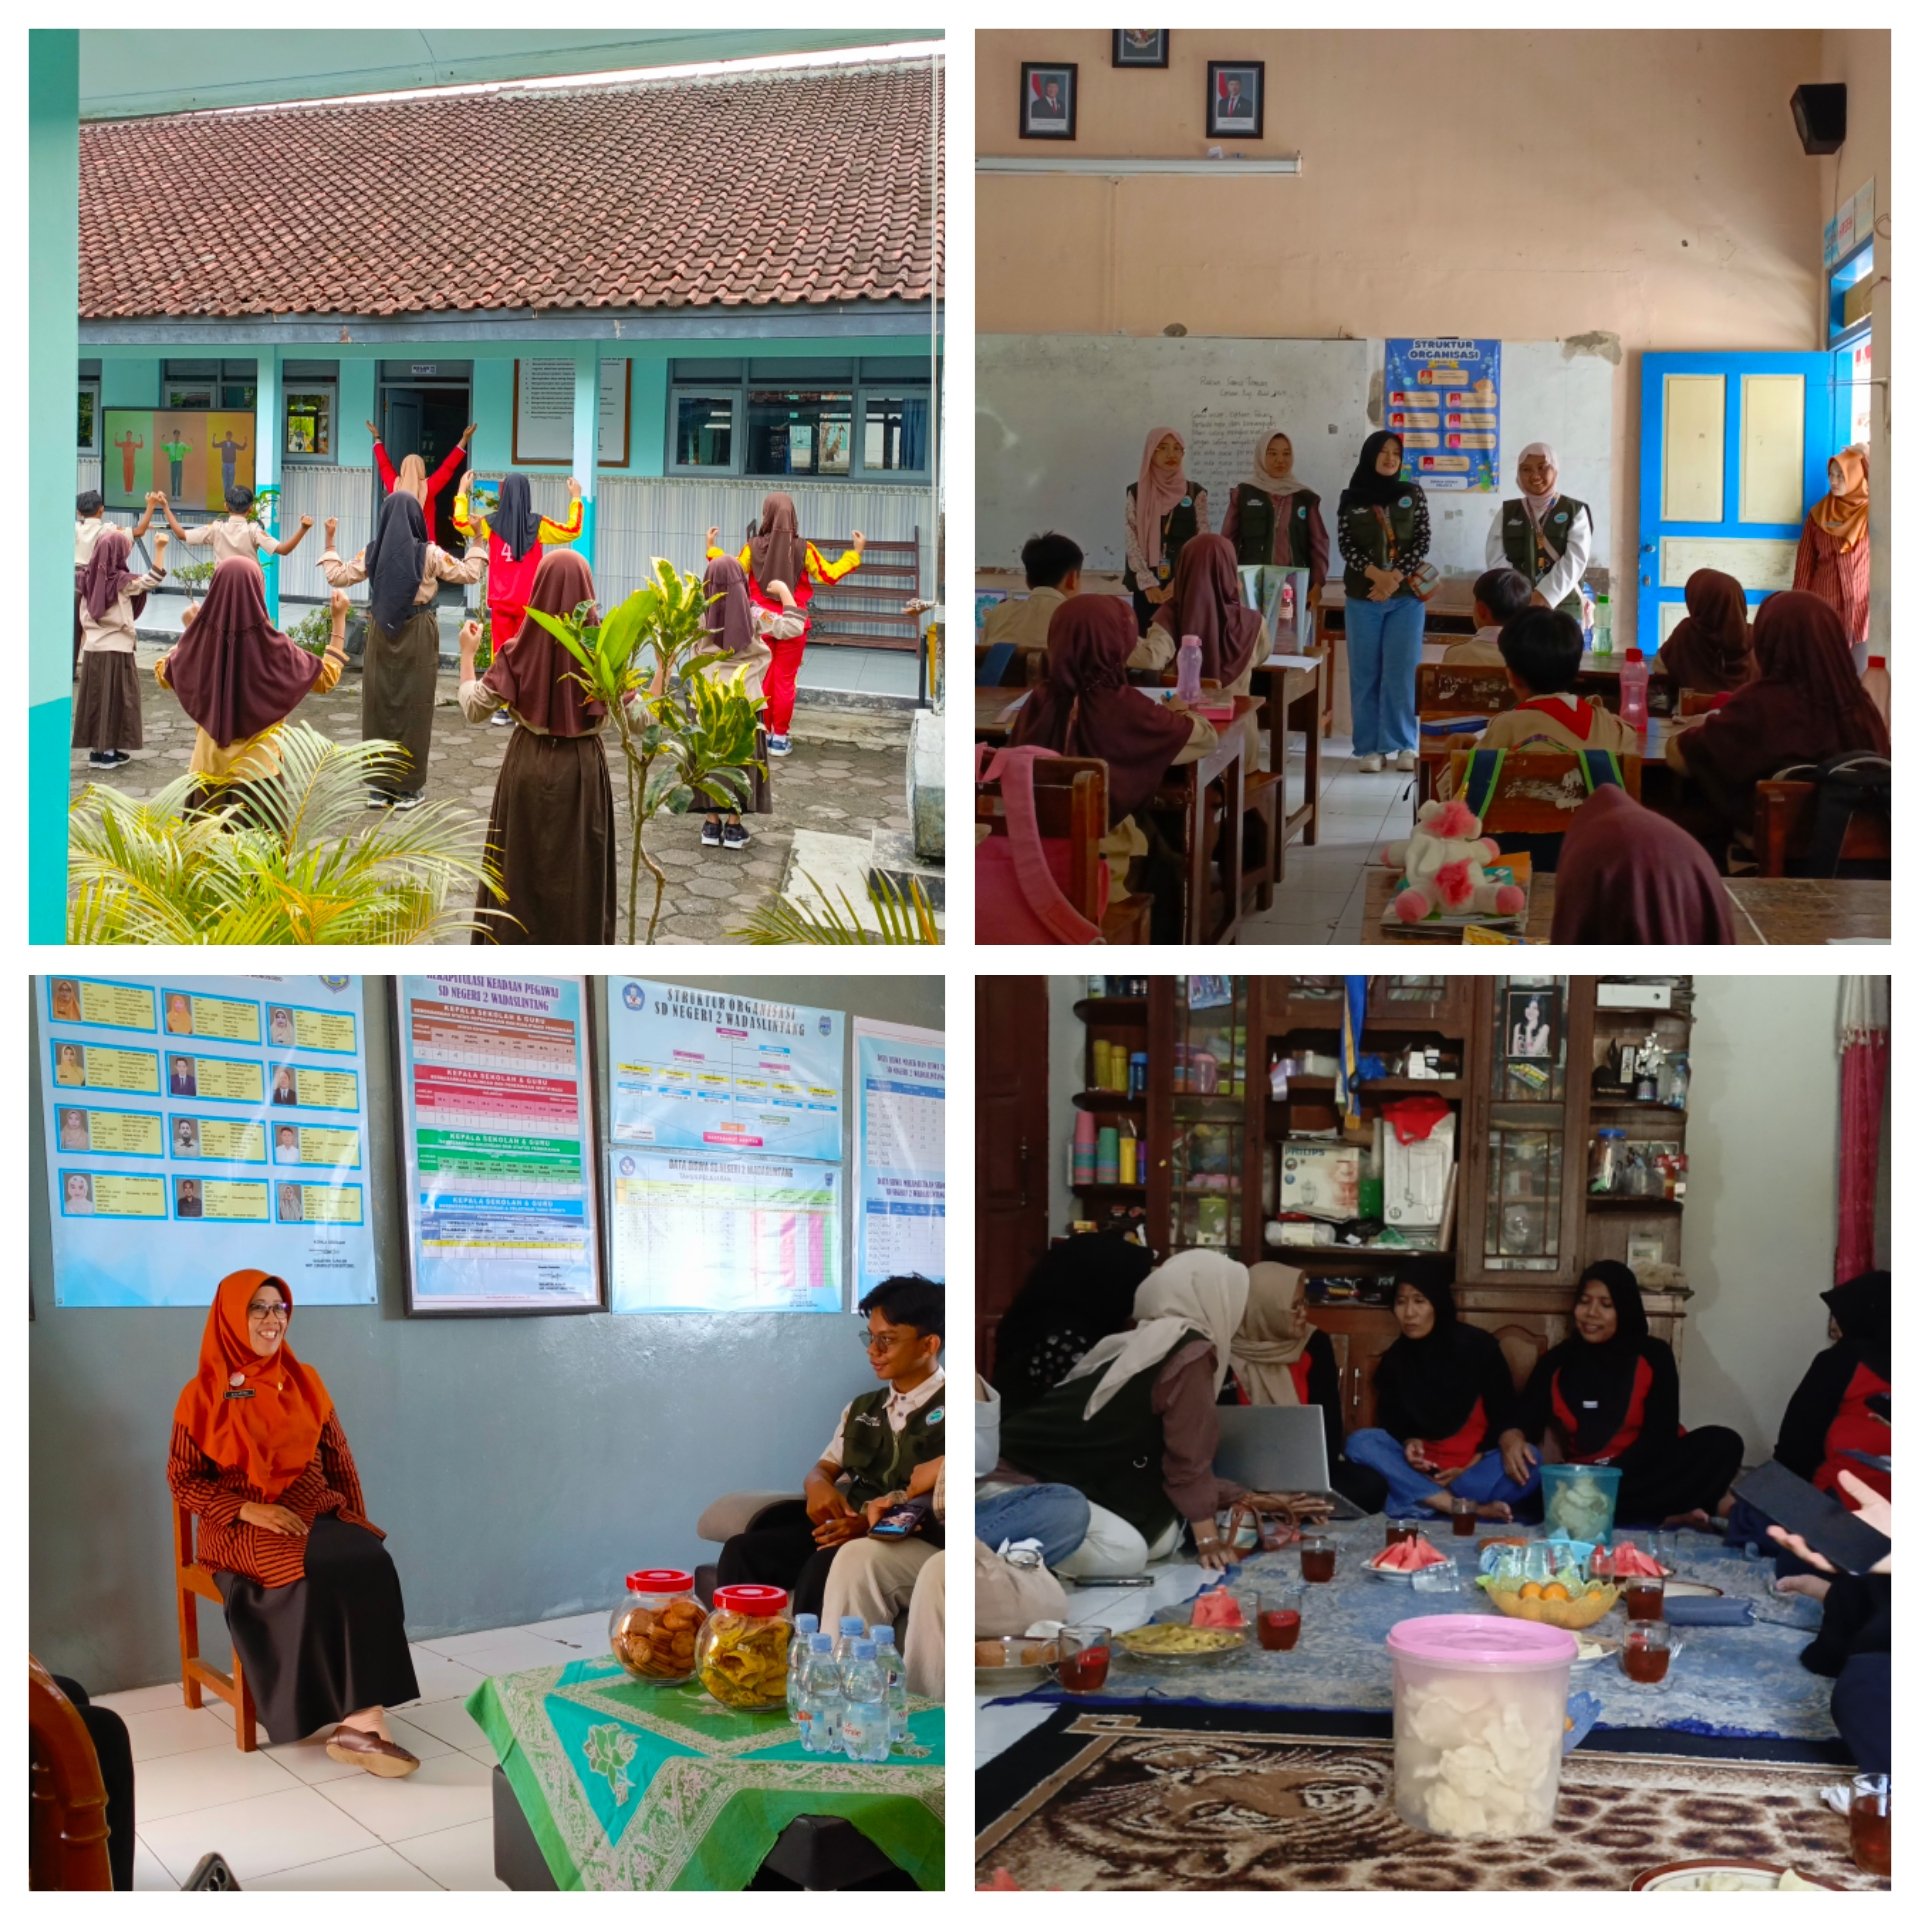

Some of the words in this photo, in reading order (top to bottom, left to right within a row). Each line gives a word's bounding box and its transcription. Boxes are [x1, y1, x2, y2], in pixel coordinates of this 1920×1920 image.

[1414, 340, 1473, 349] STRUKTUR
[1410, 350, 1478, 359] ORGANISASI
[486, 977, 522, 993] KEADAAN
[525, 982, 559, 998] PEGAWAI
[438, 985, 449, 997] SD
[451, 986, 480, 1001] NEGERI
[482, 992, 488, 1003] 2
[490, 992, 550, 1012] WADASLINTANG
[666, 988, 726, 1010] STRUKTUR
[729, 998, 796, 1020] ORGANISASI
[444, 1005, 476, 1015] KEPALA
[478, 1010, 514, 1020] SEKOLAH
[654, 1001, 668, 1015] SD
[672, 1003, 714, 1023] NEGERI
[715, 1011, 722, 1025] 2
[726, 1013, 805, 1036] WADASLINTANG
[447, 1070, 478, 1079] KEPALA
[480, 1073, 517, 1083] SEKOLAH
[526, 1078, 548, 1086] GURU
[450, 1132, 481, 1141] KEPALA
[483, 1136, 519, 1145] SEKOLAH
[486, 1198, 522, 1206] SEKOLAH
